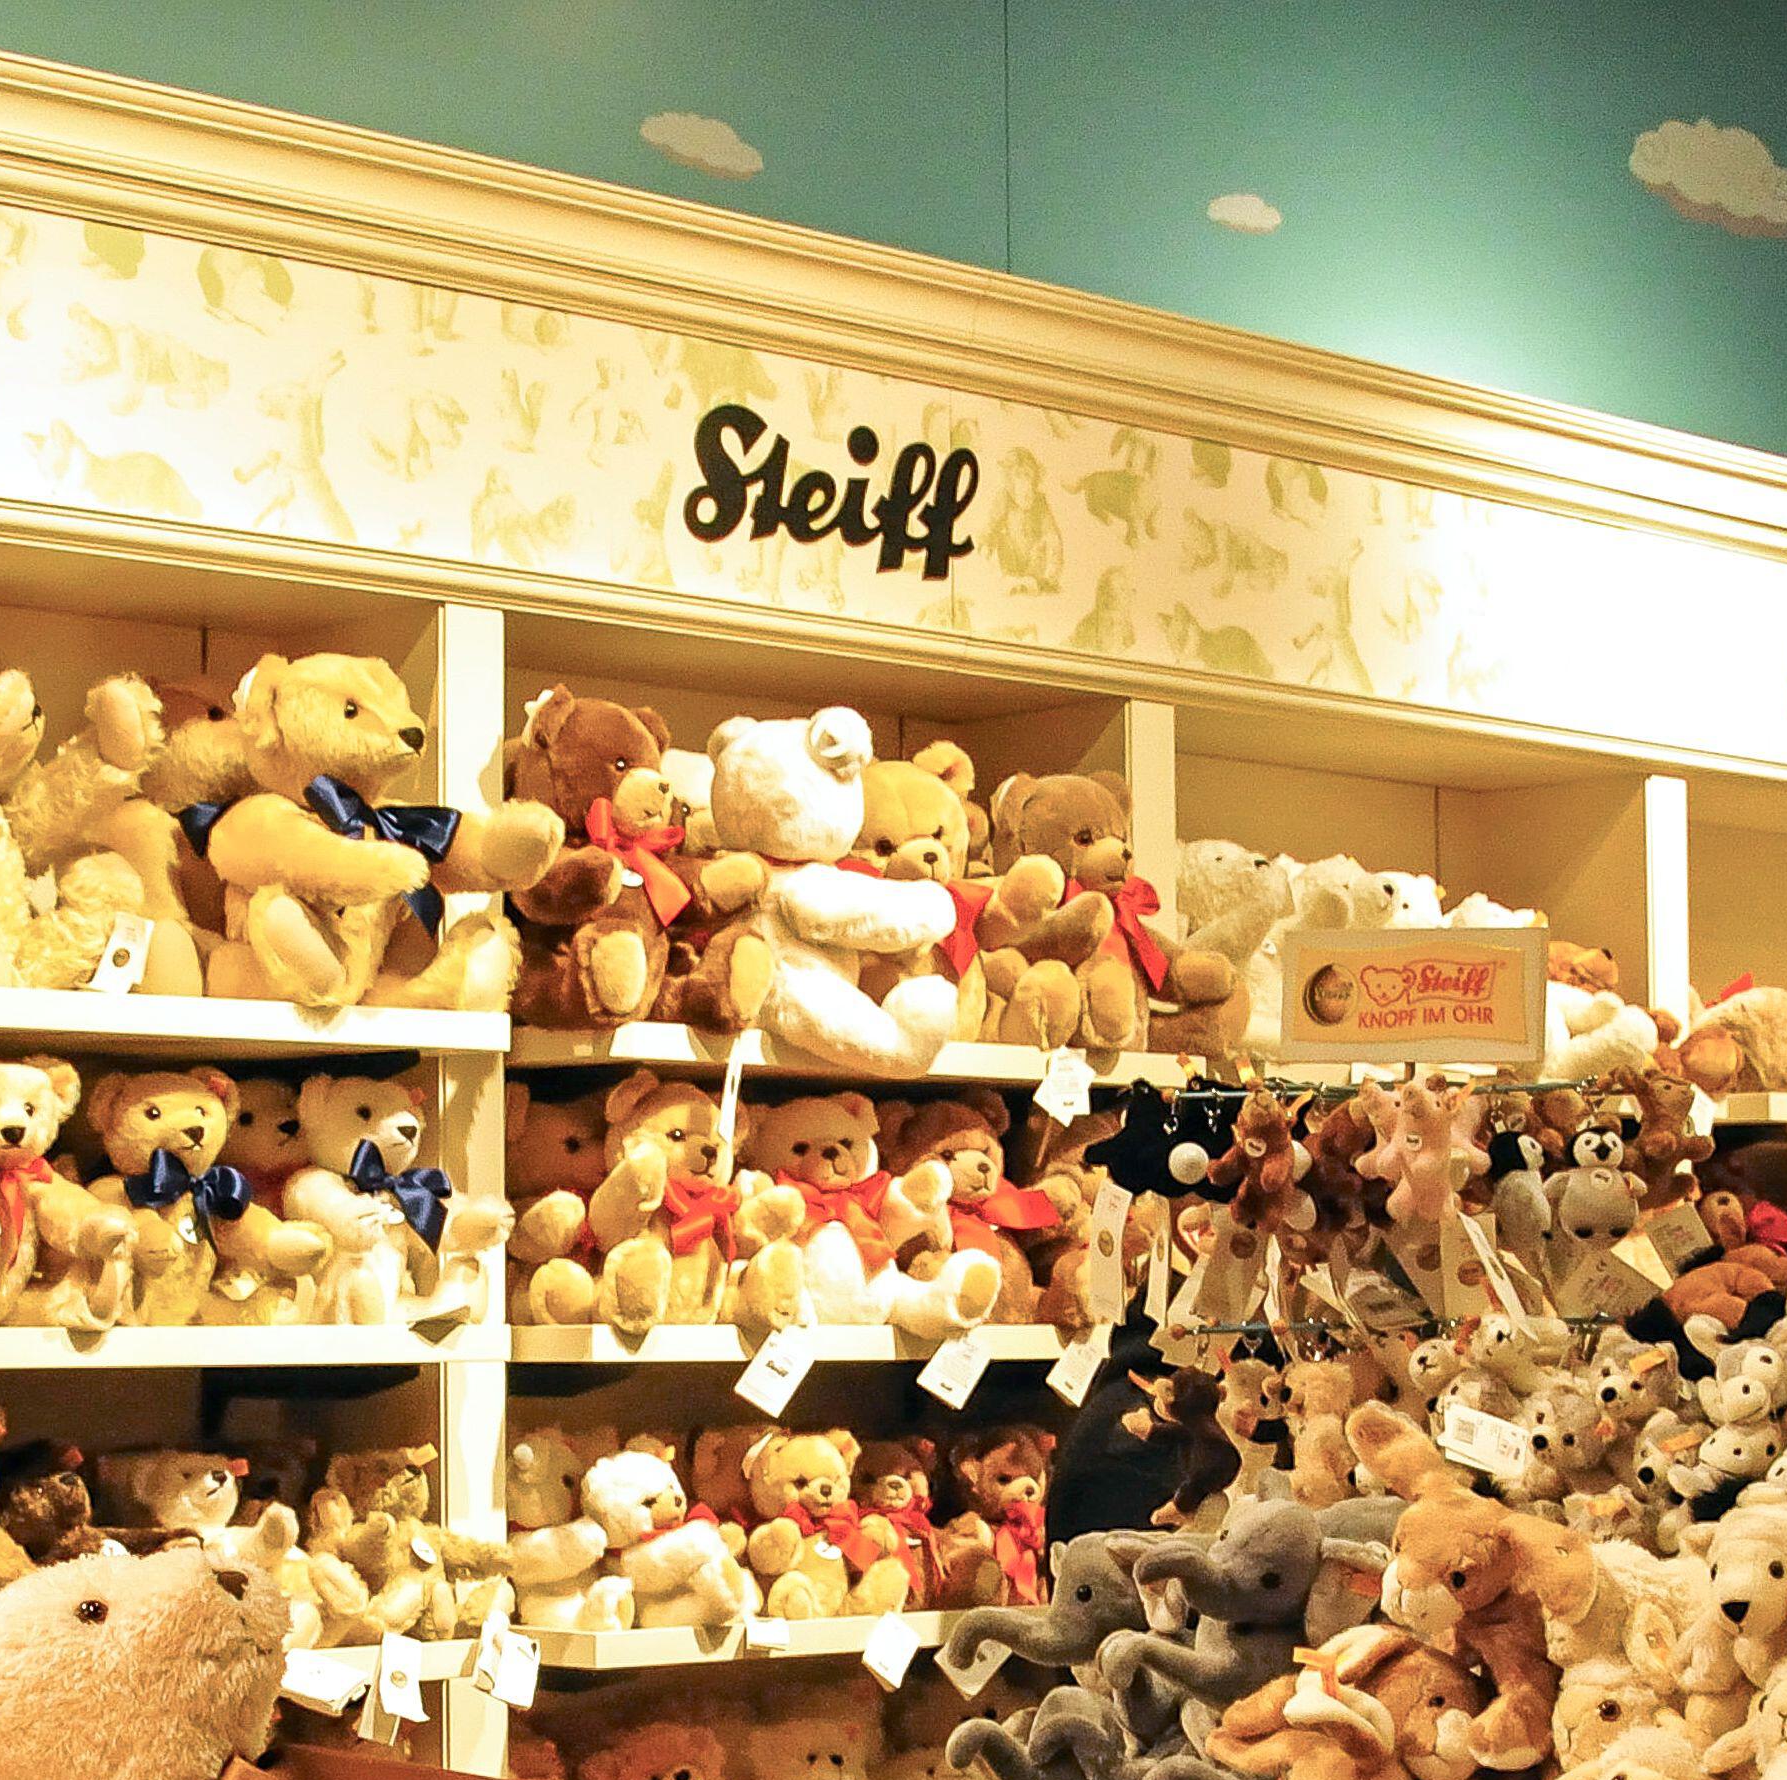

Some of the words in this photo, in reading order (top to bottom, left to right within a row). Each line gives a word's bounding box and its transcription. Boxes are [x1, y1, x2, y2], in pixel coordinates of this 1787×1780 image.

[683, 403, 979, 581] Steiff
[1417, 965, 1490, 996] Steiff
[1358, 1008, 1417, 1029] KNOPF
[1423, 1007, 1445, 1025] IM
[1453, 1005, 1493, 1025] OHR
